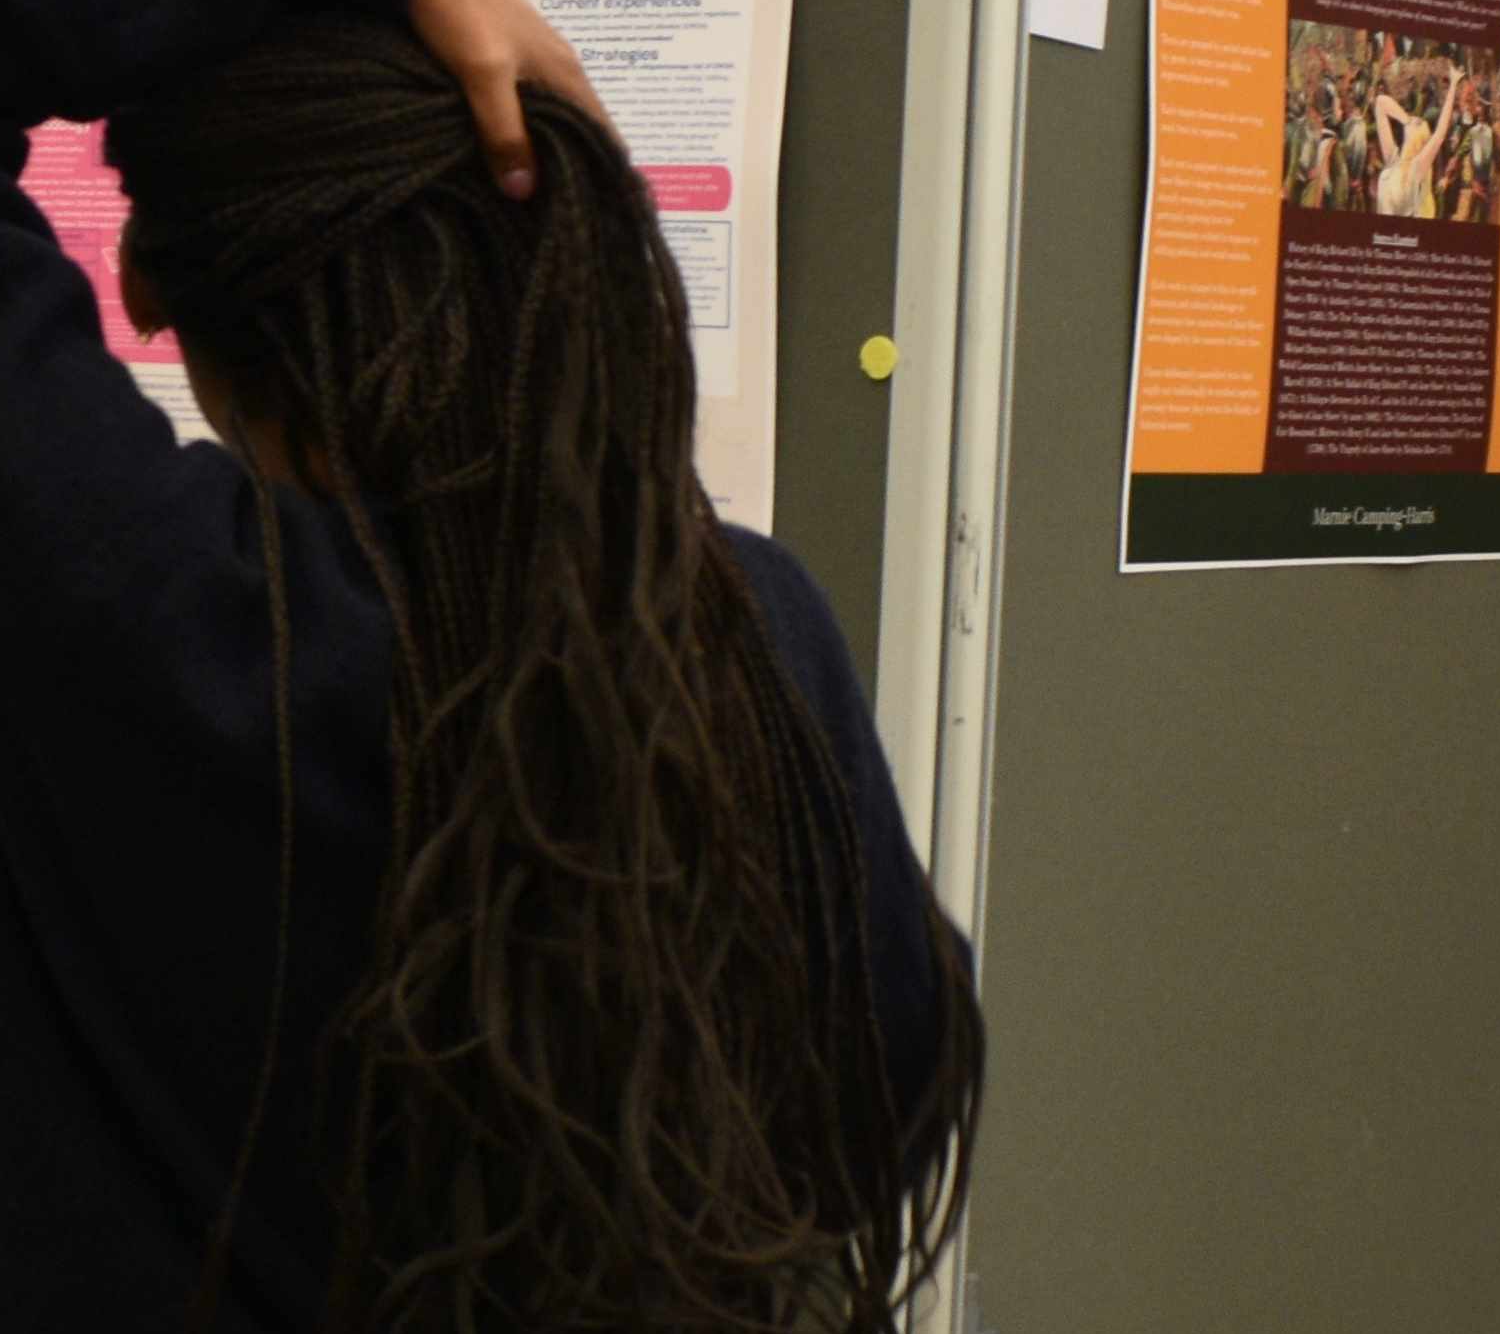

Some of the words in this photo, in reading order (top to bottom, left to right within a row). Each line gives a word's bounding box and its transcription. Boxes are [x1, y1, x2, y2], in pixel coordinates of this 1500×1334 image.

[577, 48, 662, 66] Strategies
[1313, 507, 1352, 525] Marnie
[1351, 506, 1434, 530] Camping-Harris
